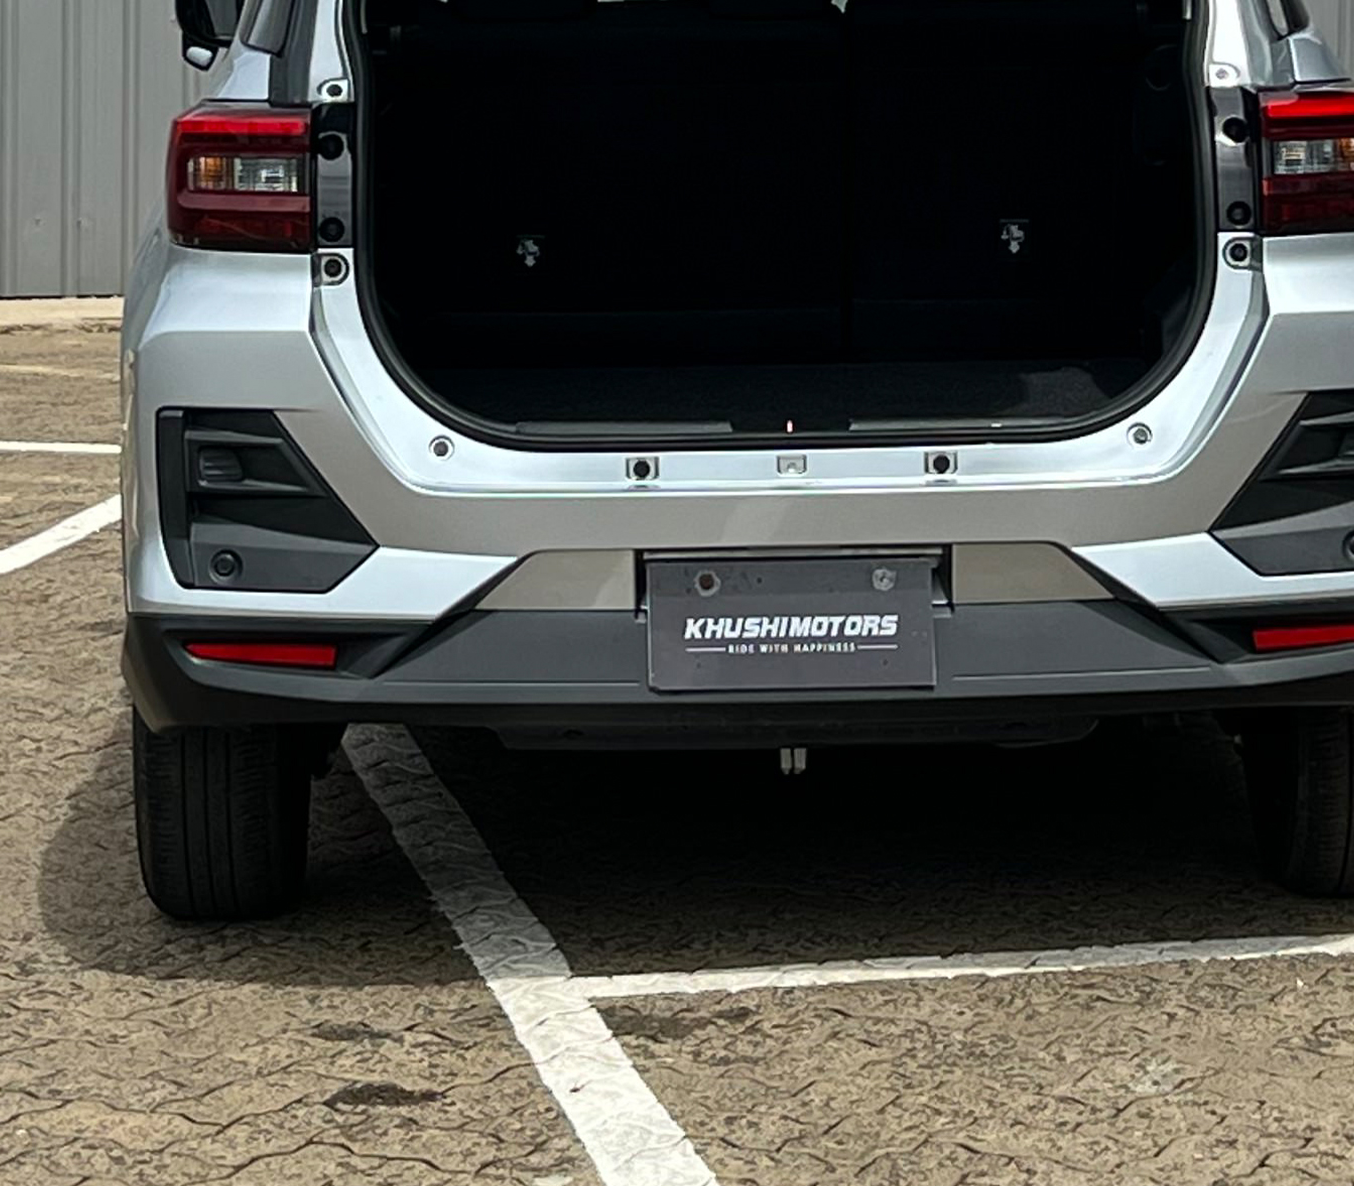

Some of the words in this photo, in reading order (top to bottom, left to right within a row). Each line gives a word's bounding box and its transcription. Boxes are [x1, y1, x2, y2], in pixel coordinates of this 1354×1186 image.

[728, 643, 755, 654] RIDE
[759, 643, 789, 654] WITH
[793, 642, 856, 653] HAPPINESS
